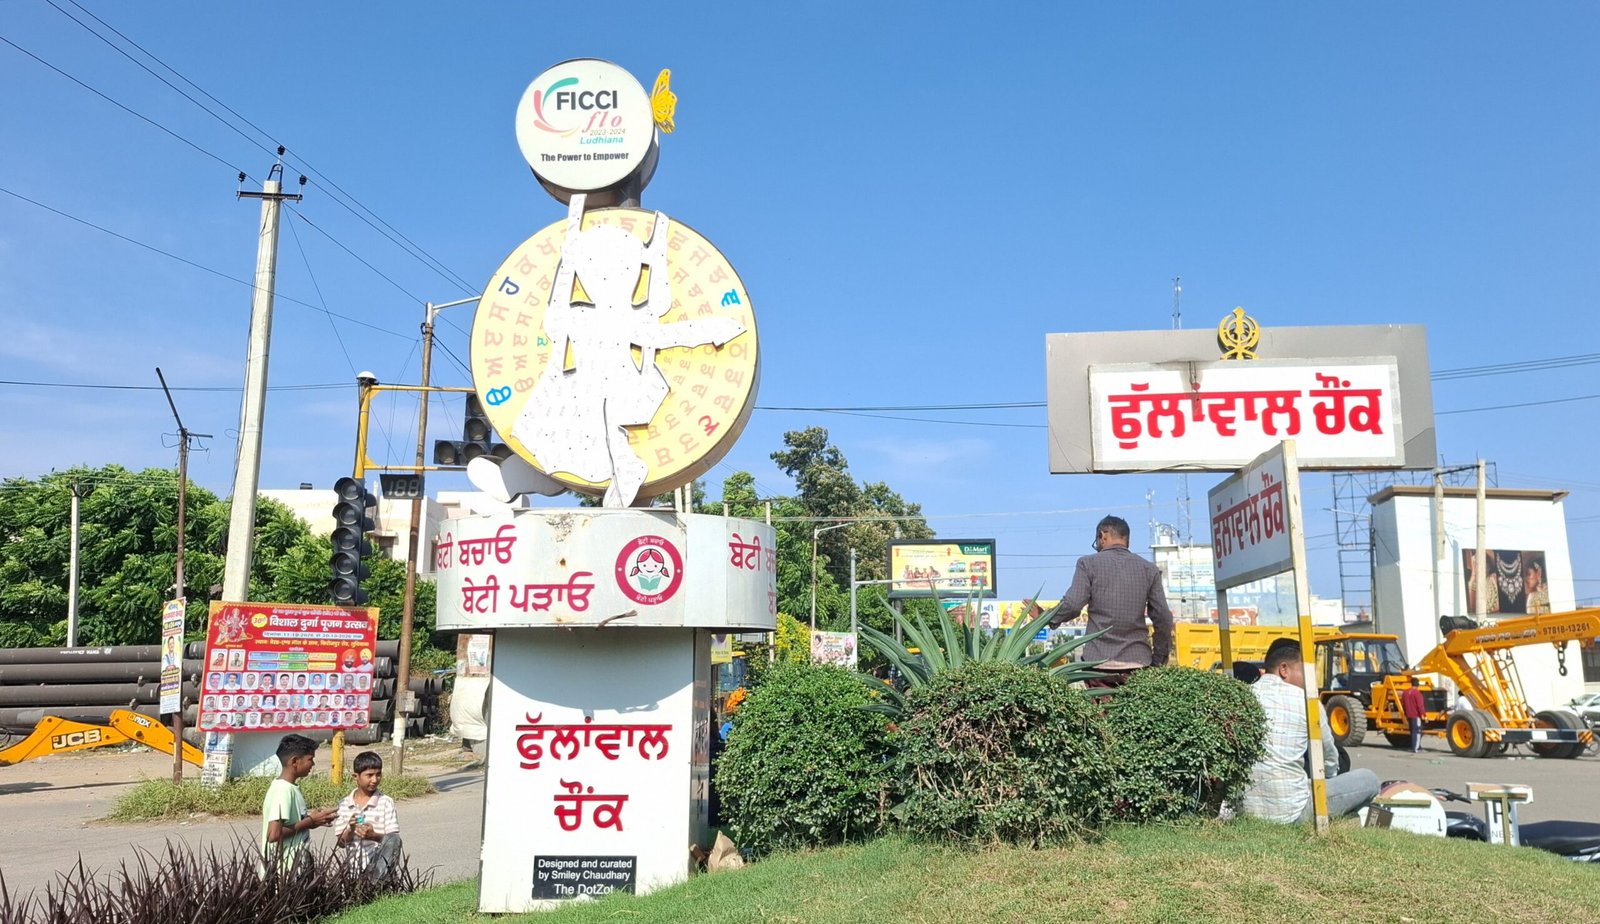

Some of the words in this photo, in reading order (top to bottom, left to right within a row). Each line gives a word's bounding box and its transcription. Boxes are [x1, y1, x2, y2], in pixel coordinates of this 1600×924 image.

[557, 90, 617, 110] FICCI
[582, 111, 622, 132] flo
[580, 136, 624, 144] Ludhiana
[590, 128, 626, 136] 2023-2024
[593, 152, 629, 160] Empower
[1108, 382, 1302, 450] ਫੁੱਲਾਂਵਾਲ
[1309, 372, 1384, 435] ਚੌਂਕ
[458, 524, 517, 566] ਬਚਾਓ
[729, 533, 761, 571] ਬੇਟੀ
[462, 575, 500, 614] ਬੇਟੀ
[509, 572, 595, 612] ਪੜਾਓ
[270, 615, 298, 627] विशाल
[300, 616, 319, 630] दुर्गा
[321, 620, 342, 631] पूजन
[345, 620, 368, 629] उत्सव
[52, 730, 101, 749] JCB
[516, 712, 672, 770] ਫੁੱਲਾਂਵਾਲ
[554, 778, 629, 831] ਚੌਂਕ
[538, 859, 579, 870] Designed
[581, 859, 597, 868] and
[600, 859, 632, 868] curated
[538, 871, 549, 881] by
[551, 870, 580, 881] Smiley
[583, 870, 630, 881] Chaudhary
[554, 884, 574, 894] The
[578, 884, 614, 894] DotZot
